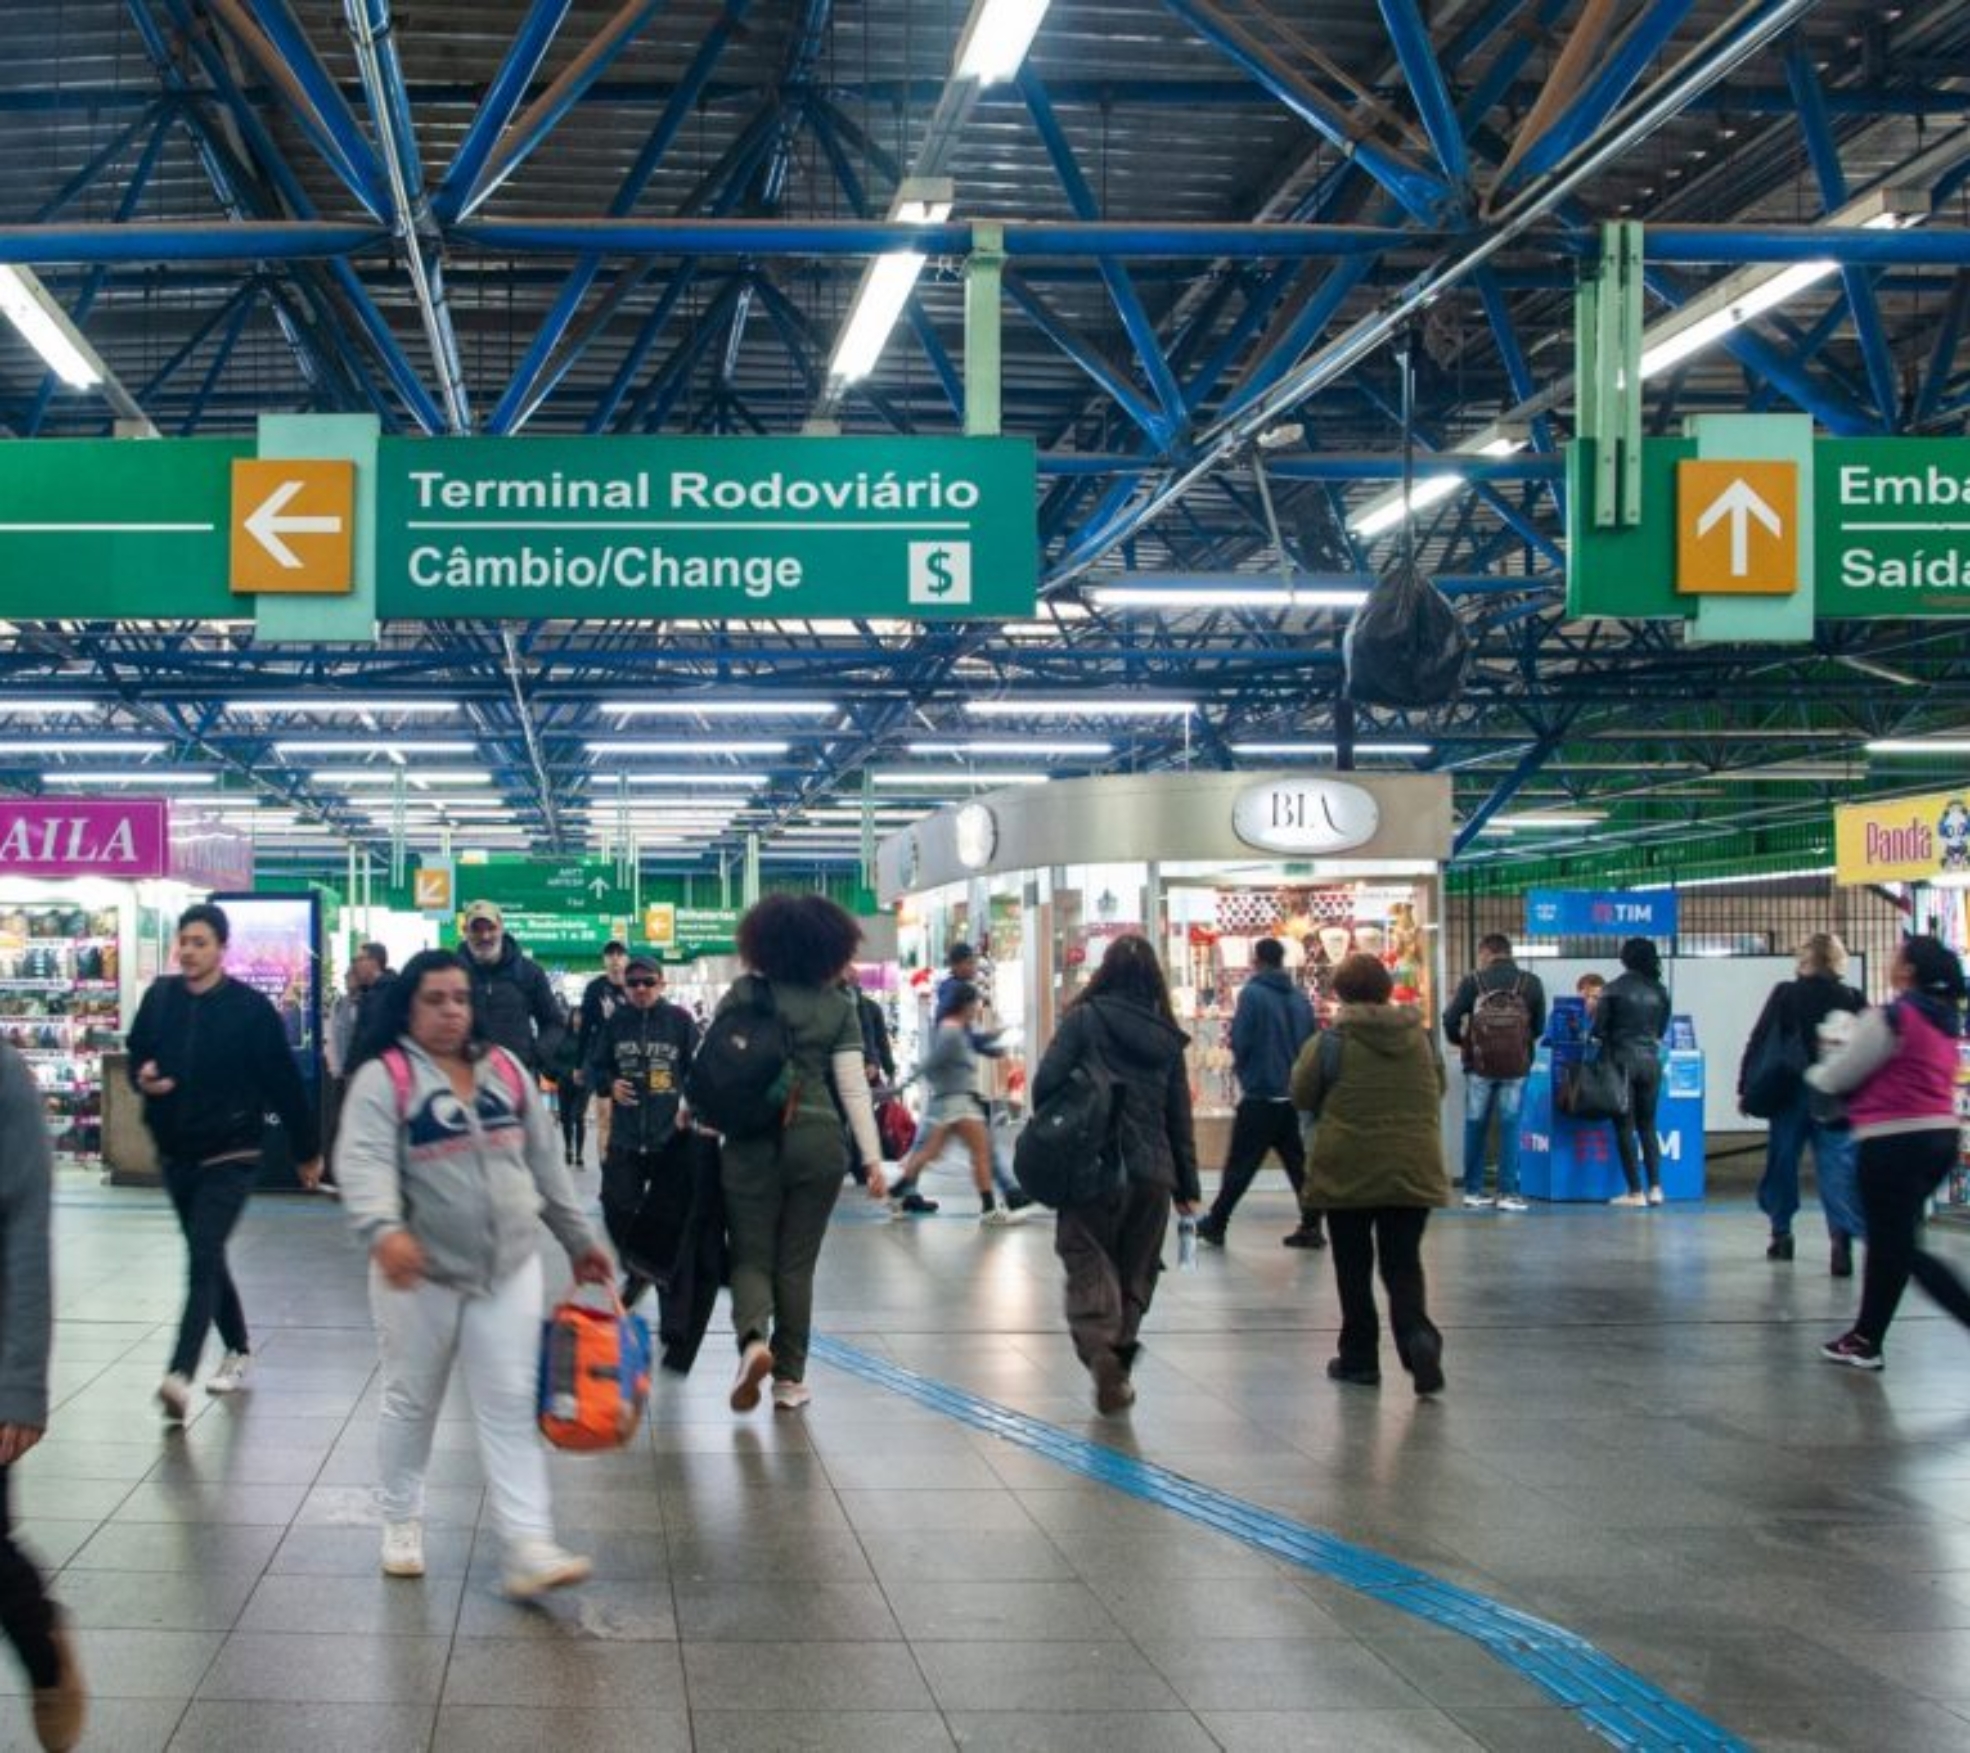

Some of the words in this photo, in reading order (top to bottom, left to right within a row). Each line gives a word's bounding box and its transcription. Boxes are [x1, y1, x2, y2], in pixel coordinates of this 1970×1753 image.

[408, 471, 649, 509] Terminal
[670, 471, 980, 509] Rodoviário
[408, 546, 803, 598] Câmbio/Change
[1866, 817, 1932, 865] Panda
[1614, 904, 1652, 922] TIM
